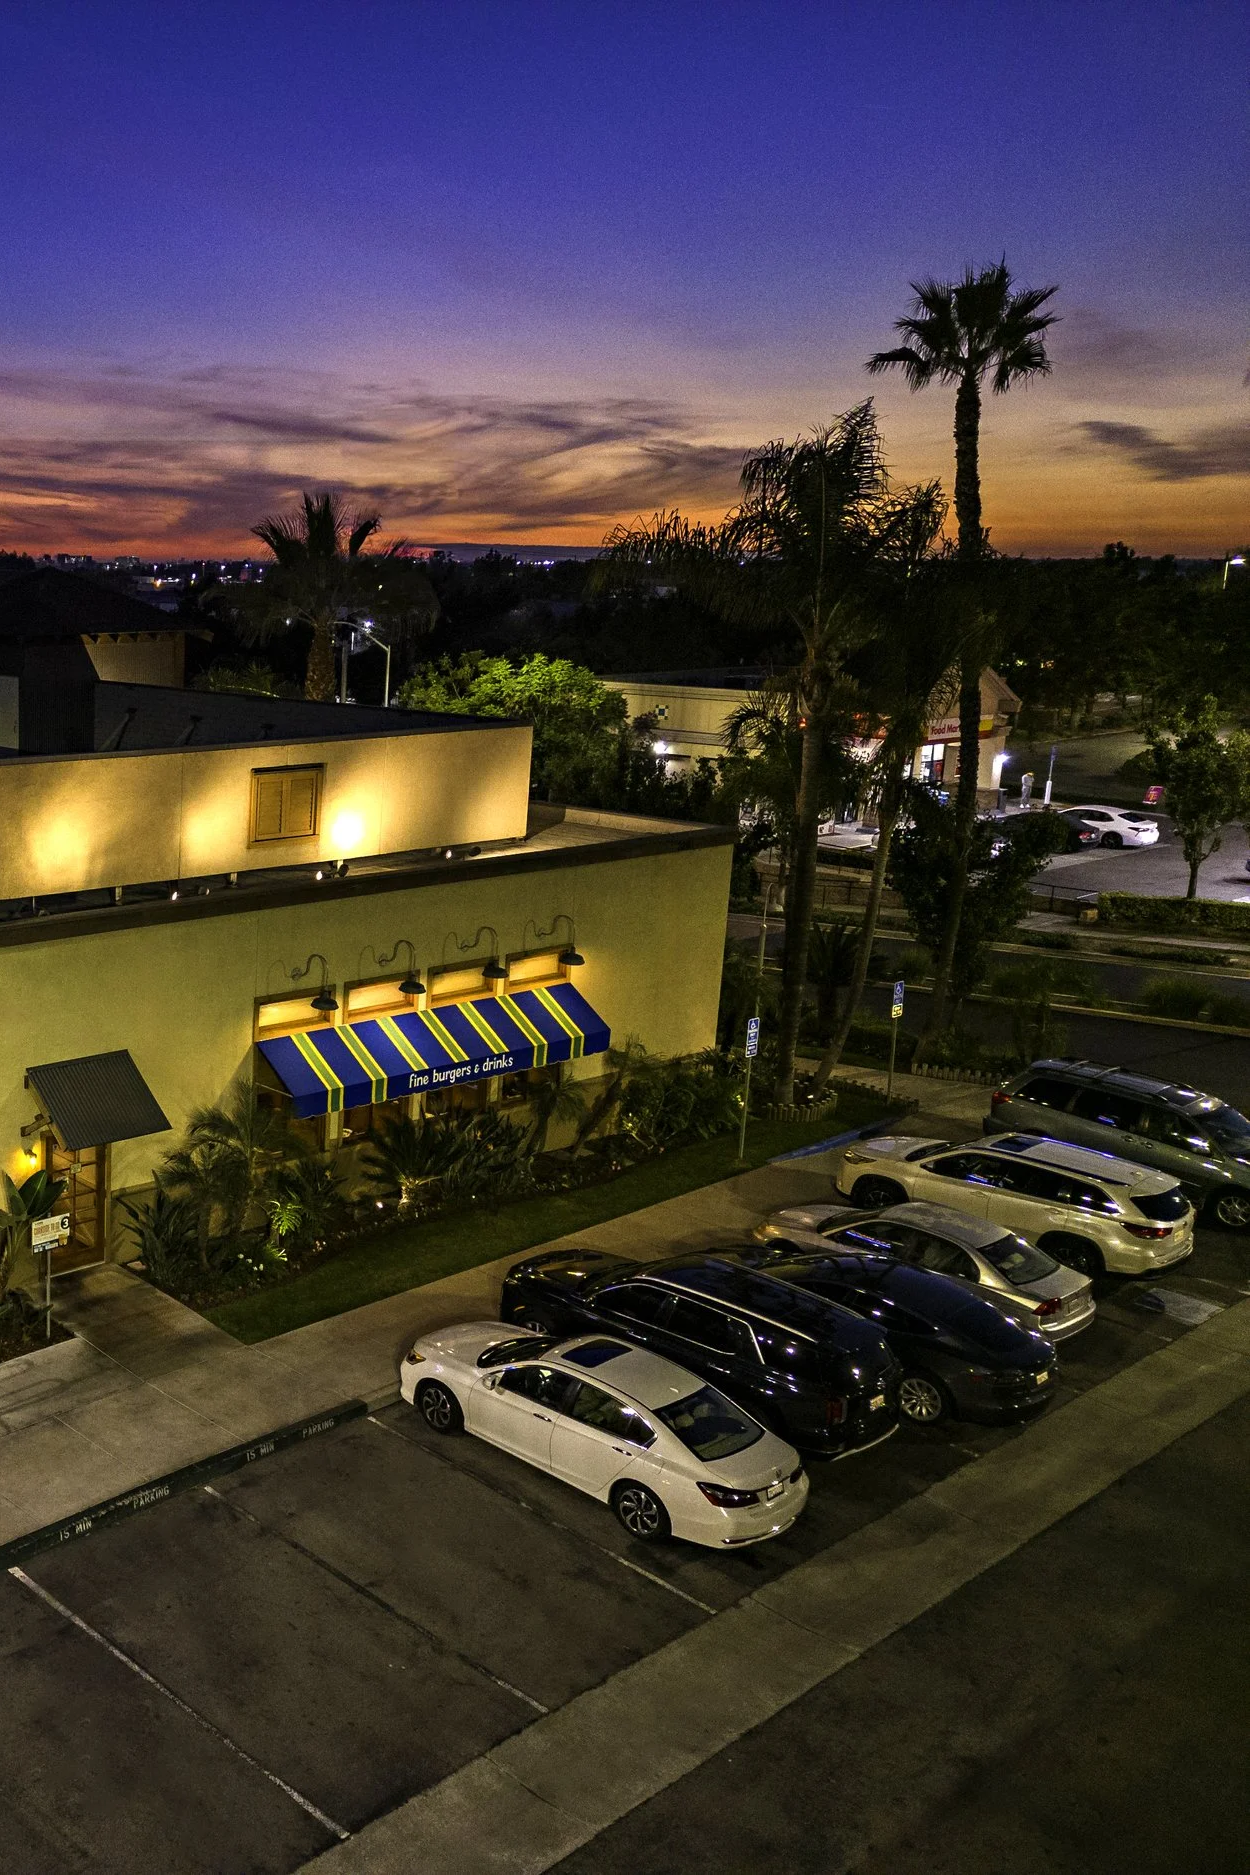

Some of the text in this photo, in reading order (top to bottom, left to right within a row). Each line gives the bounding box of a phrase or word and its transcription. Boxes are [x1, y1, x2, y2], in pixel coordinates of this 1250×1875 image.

[931, 725, 945, 735] Food
[409, 1054, 514, 1088] fine burgers & drinks
[302, 1418, 335, 1439] PARKING
[246, 1442, 275, 1462] 15 MIN
[133, 1485, 170, 1509] PARKING
[59, 1518, 92, 1541] 15 MIN
